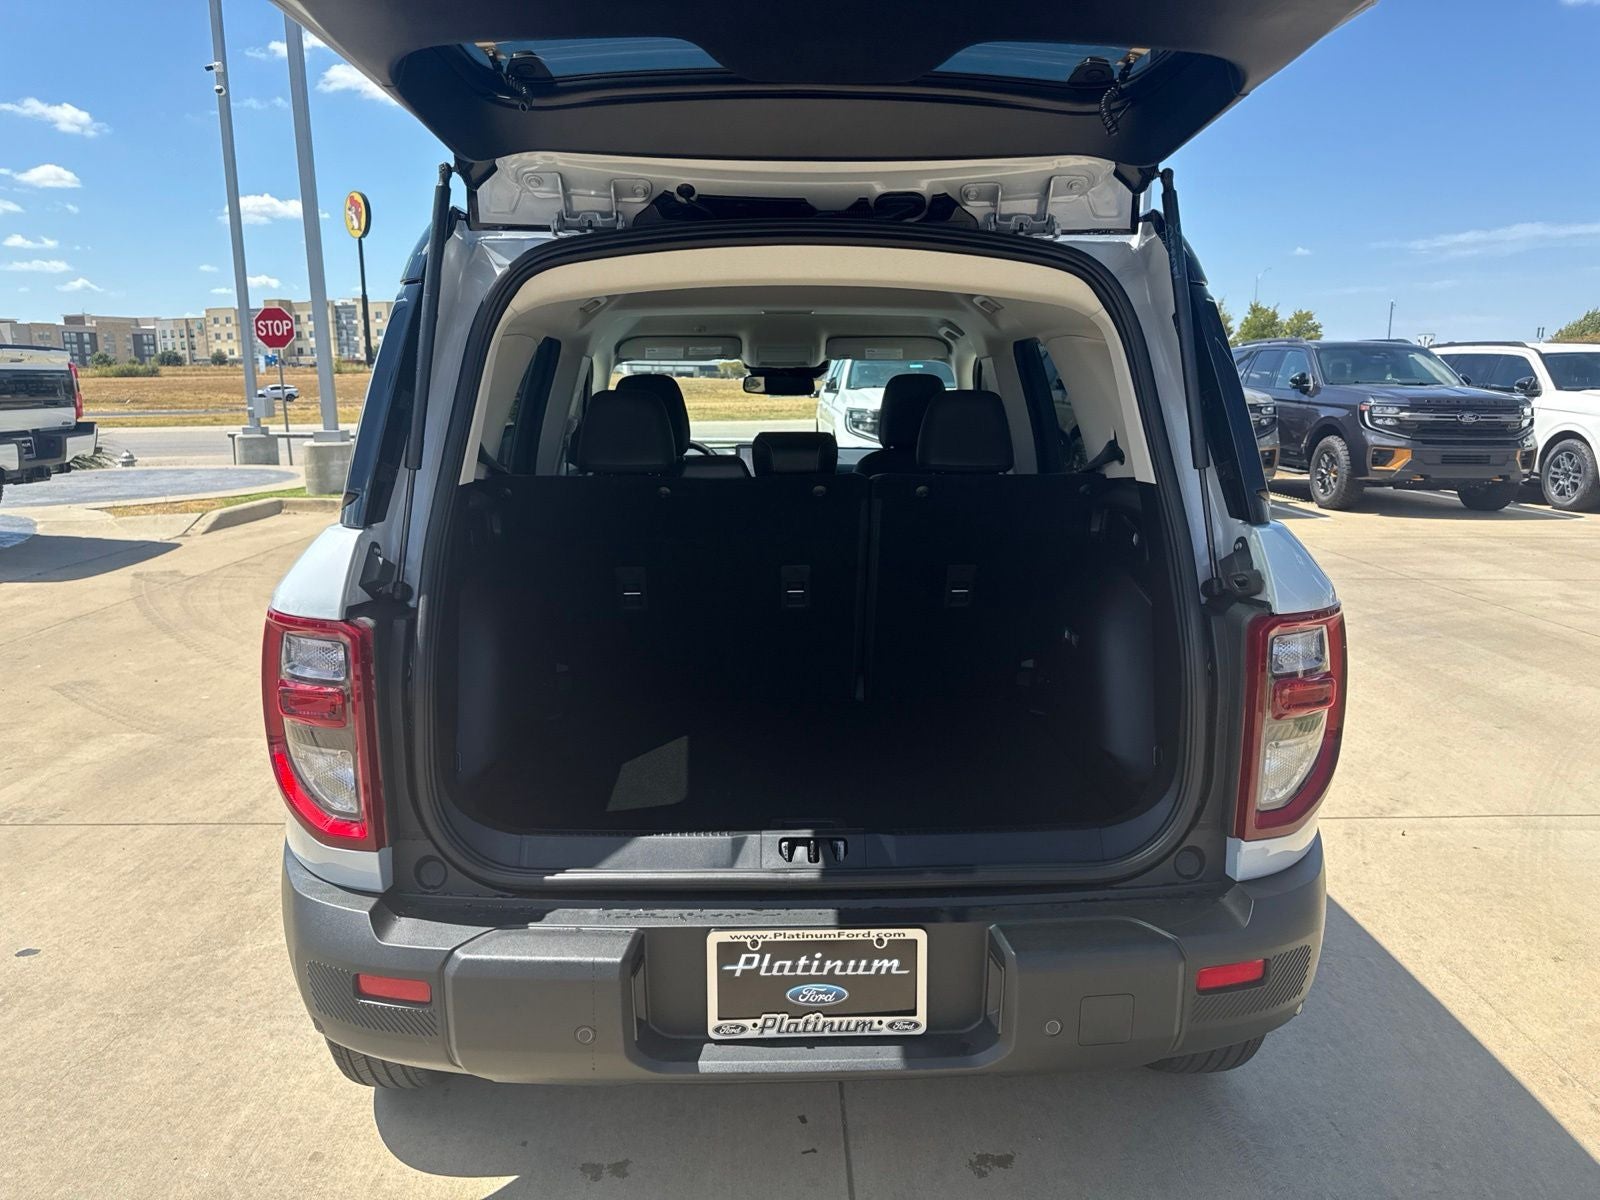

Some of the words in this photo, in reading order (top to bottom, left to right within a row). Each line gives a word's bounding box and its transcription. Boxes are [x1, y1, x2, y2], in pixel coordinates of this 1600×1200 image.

[257, 320, 292, 336] STOP
[729, 931, 906, 940] www.PlatinumFord.com
[722, 952, 910, 976] Platinum
[798, 987, 837, 1002] Ford
[719, 1024, 741, 1034] Ford
[757, 1015, 883, 1035] Platinum
[892, 1020, 914, 1030] Ford
